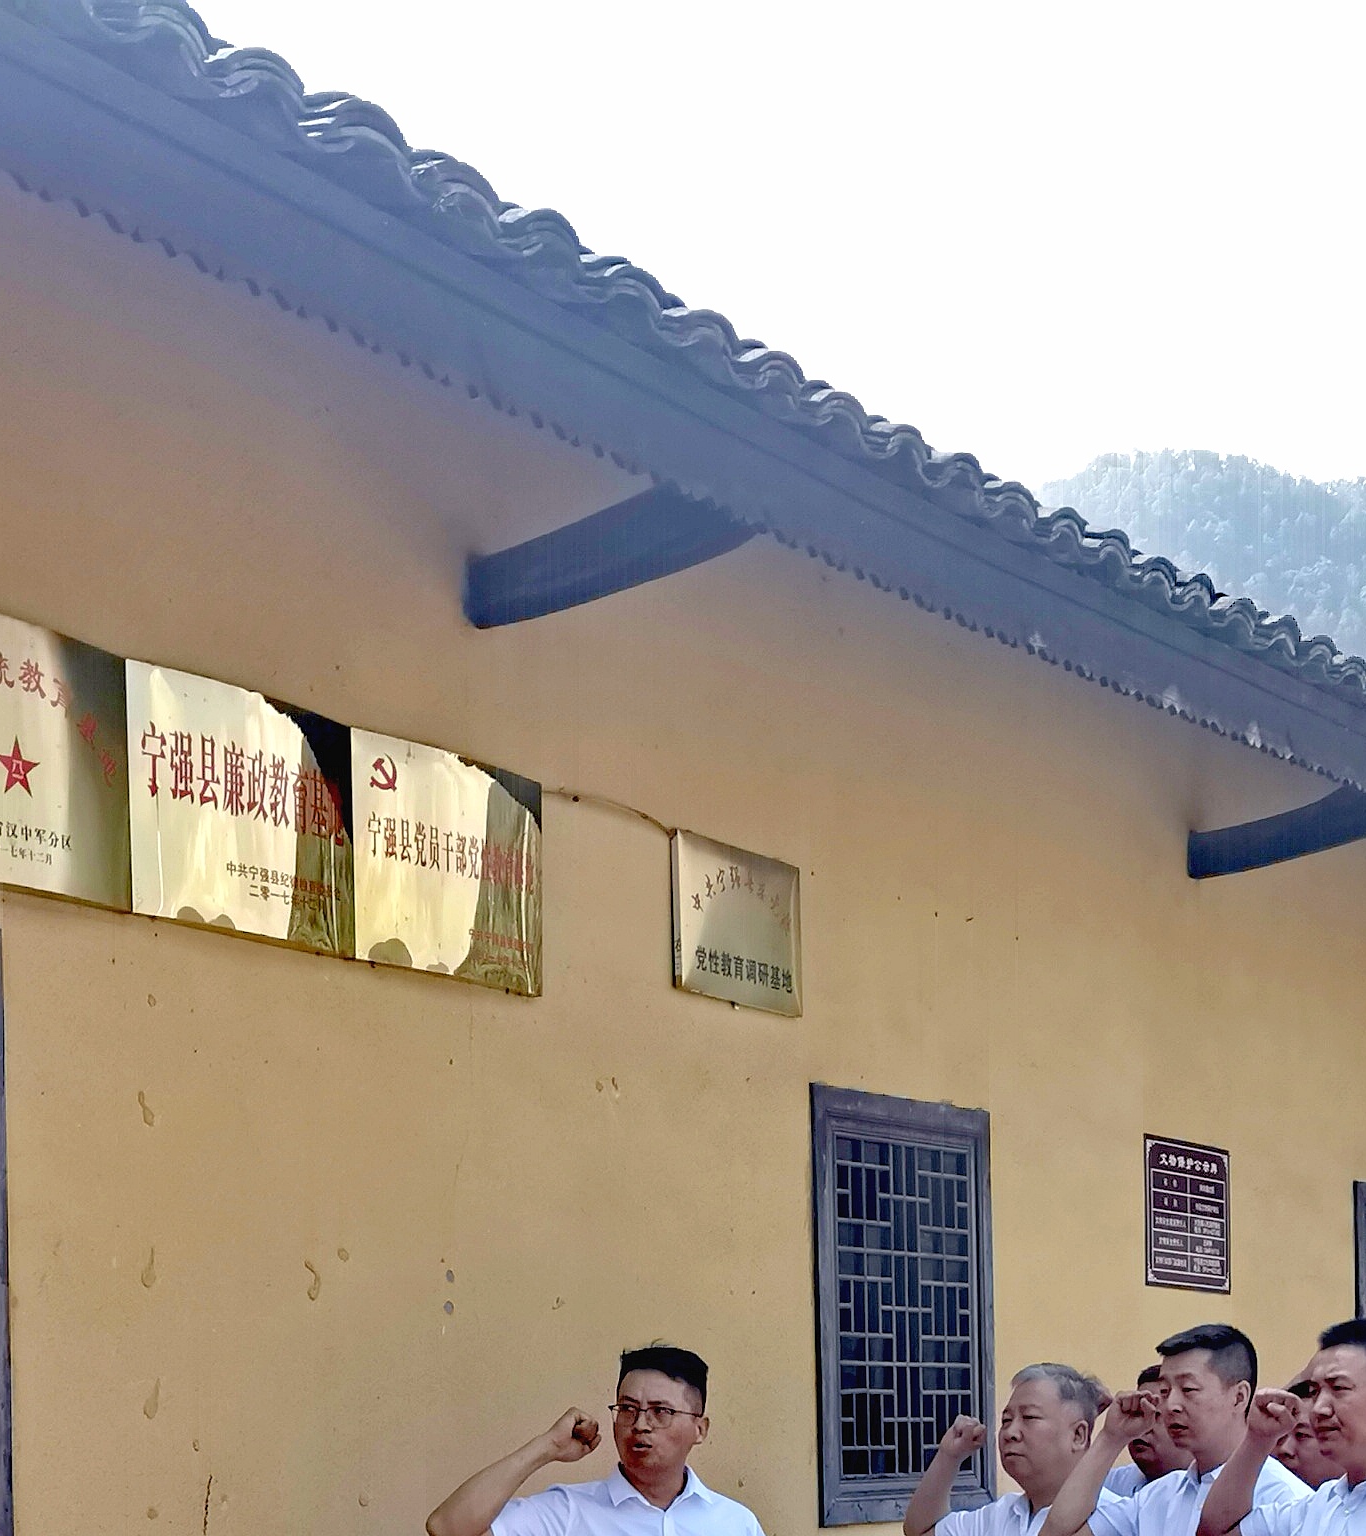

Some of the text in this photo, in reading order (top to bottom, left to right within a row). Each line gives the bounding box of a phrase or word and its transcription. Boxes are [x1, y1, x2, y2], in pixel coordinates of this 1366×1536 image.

[695, 945, 793, 994] 党性教育调研基地
